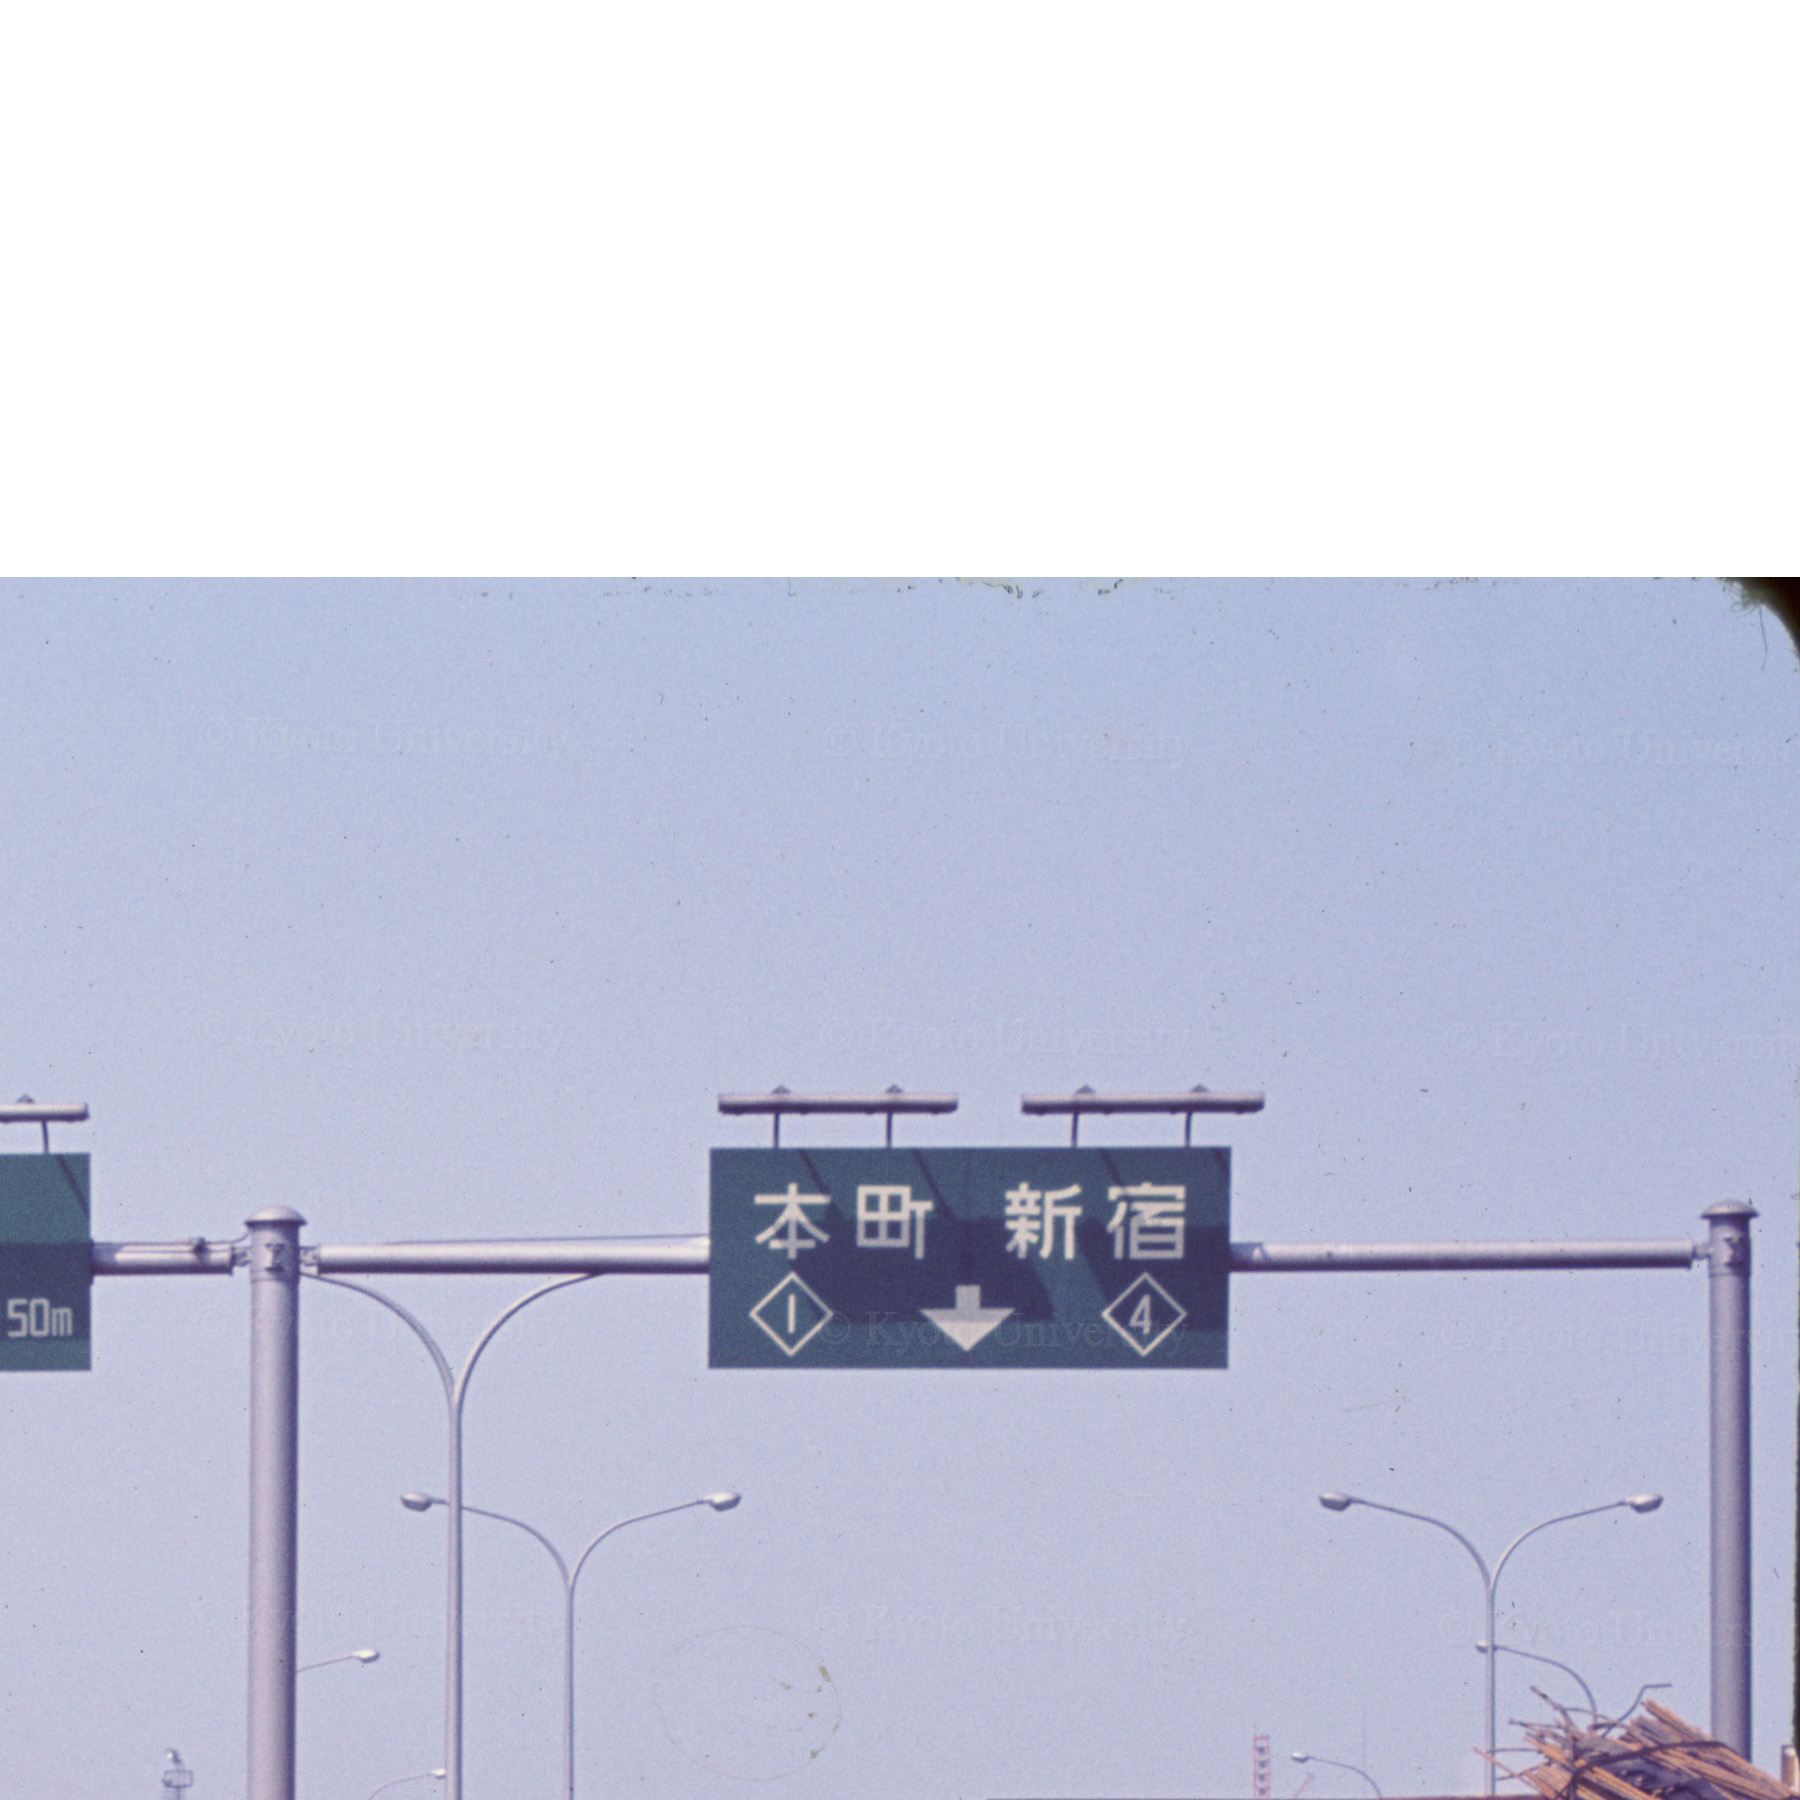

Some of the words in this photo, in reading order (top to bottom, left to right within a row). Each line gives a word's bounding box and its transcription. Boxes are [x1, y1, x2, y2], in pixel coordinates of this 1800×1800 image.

[754, 1183, 933, 1259] 本町
[1004, 1183, 1187, 1260] 新宿
[1128, 1294, 1151, 1336] 4
